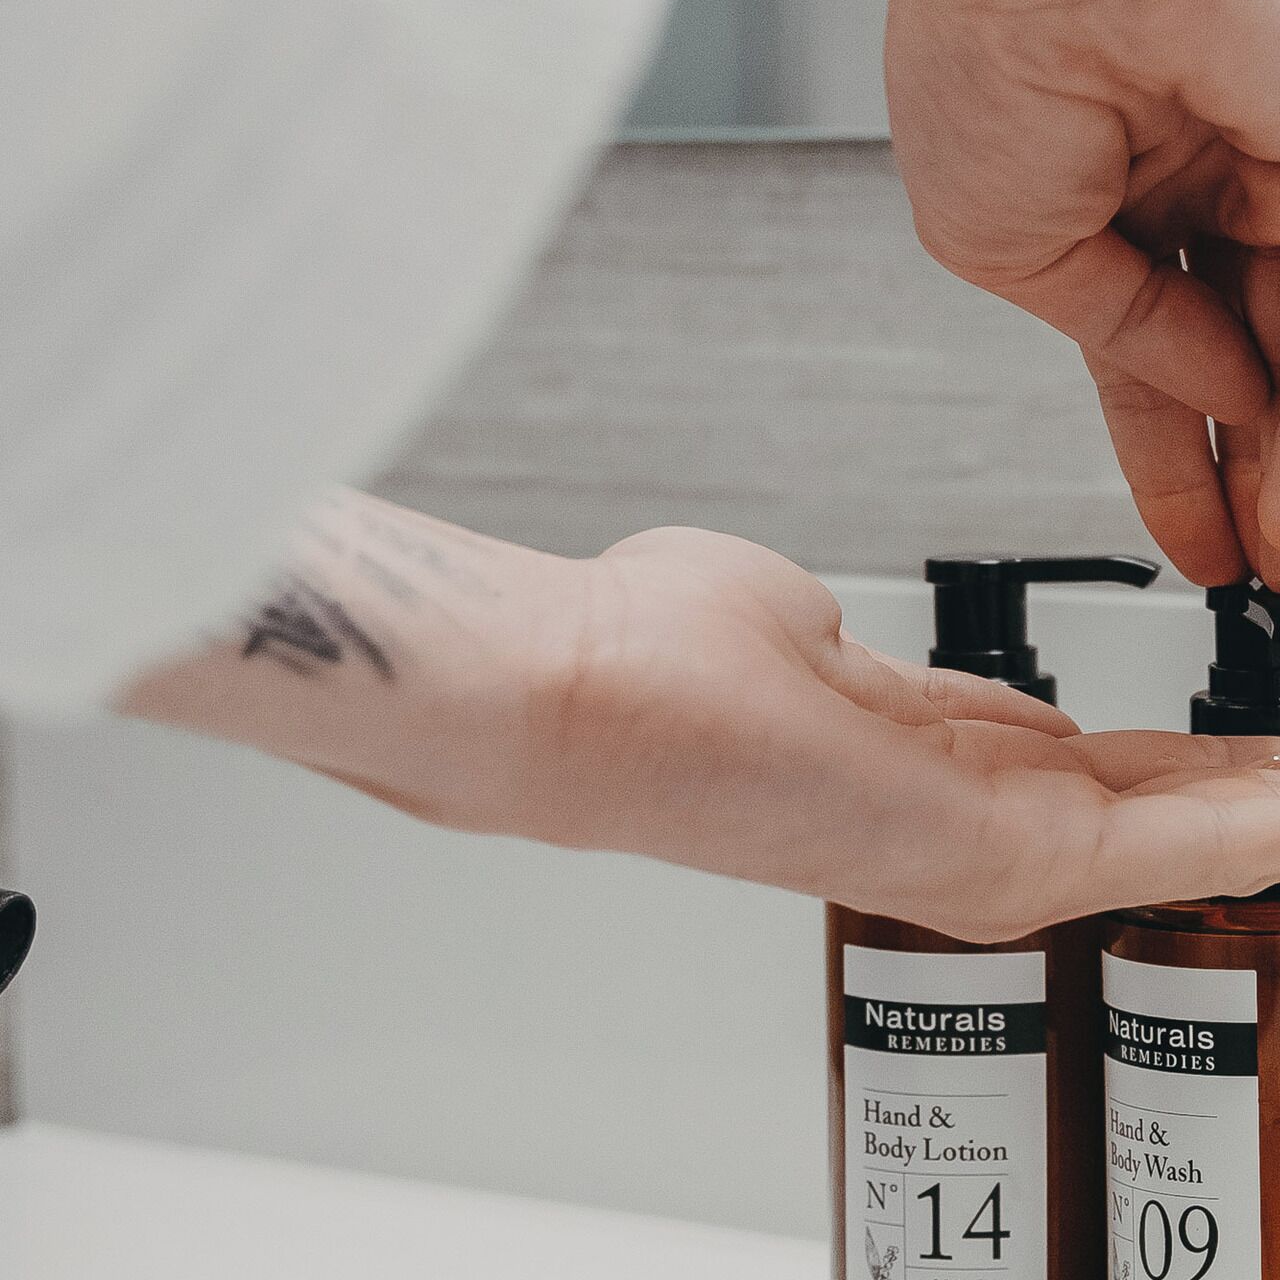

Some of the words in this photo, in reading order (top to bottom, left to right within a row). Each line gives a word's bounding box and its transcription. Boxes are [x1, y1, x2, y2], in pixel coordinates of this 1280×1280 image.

[865, 1002, 1006, 1032] Naturals
[1109, 1009, 1215, 1050] Naturals
[887, 1034, 1007, 1052] REMEDIES
[1120, 1044, 1216, 1071] REMEDIES
[863, 1099, 922, 1128] Hand
[929, 1105, 955, 1128] &
[1109, 1108, 1145, 1142] Hand
[1149, 1121, 1170, 1147] &
[863, 1131, 917, 1167] Body
[923, 1138, 1009, 1162] Lotion
[1110, 1141, 1142, 1182] Body
[1143, 1153, 1204, 1184] Wash
[917, 1182, 1010, 1260] 14
